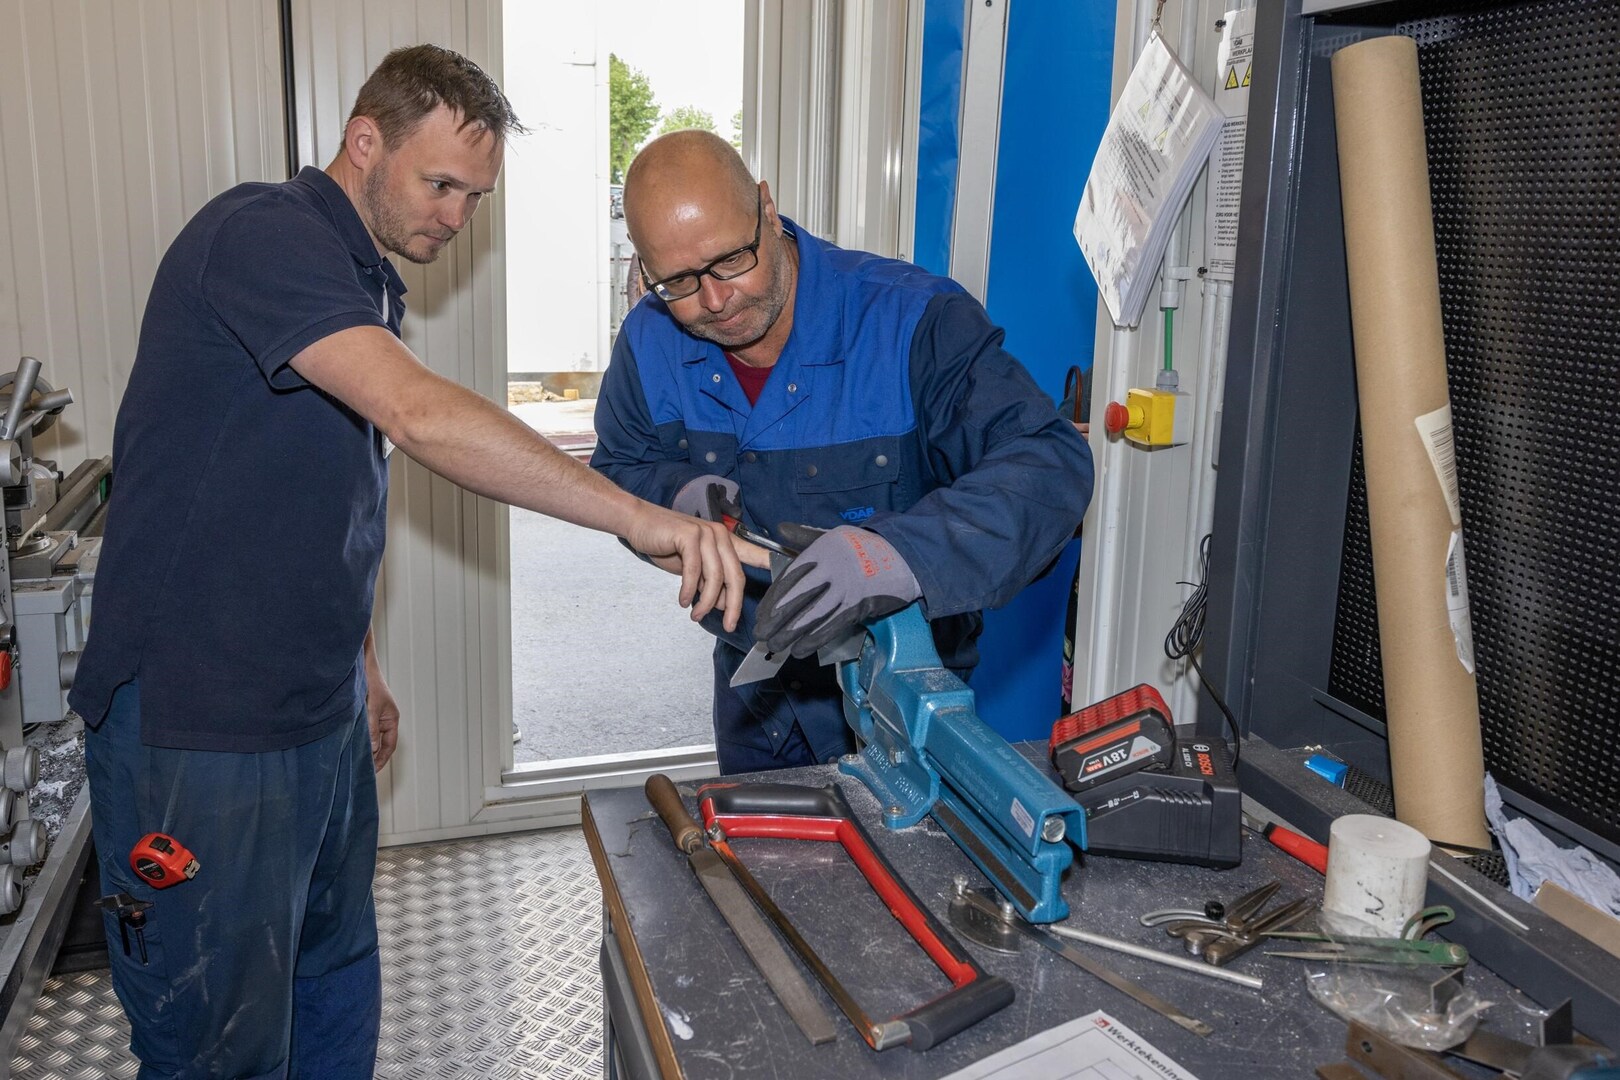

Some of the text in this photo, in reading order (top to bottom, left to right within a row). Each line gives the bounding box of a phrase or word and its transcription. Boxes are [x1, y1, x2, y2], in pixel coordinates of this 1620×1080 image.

[840, 506, 875, 522] VDAB
[1102, 748, 1128, 767] 18V
[1197, 752, 1214, 776] BOSCH
